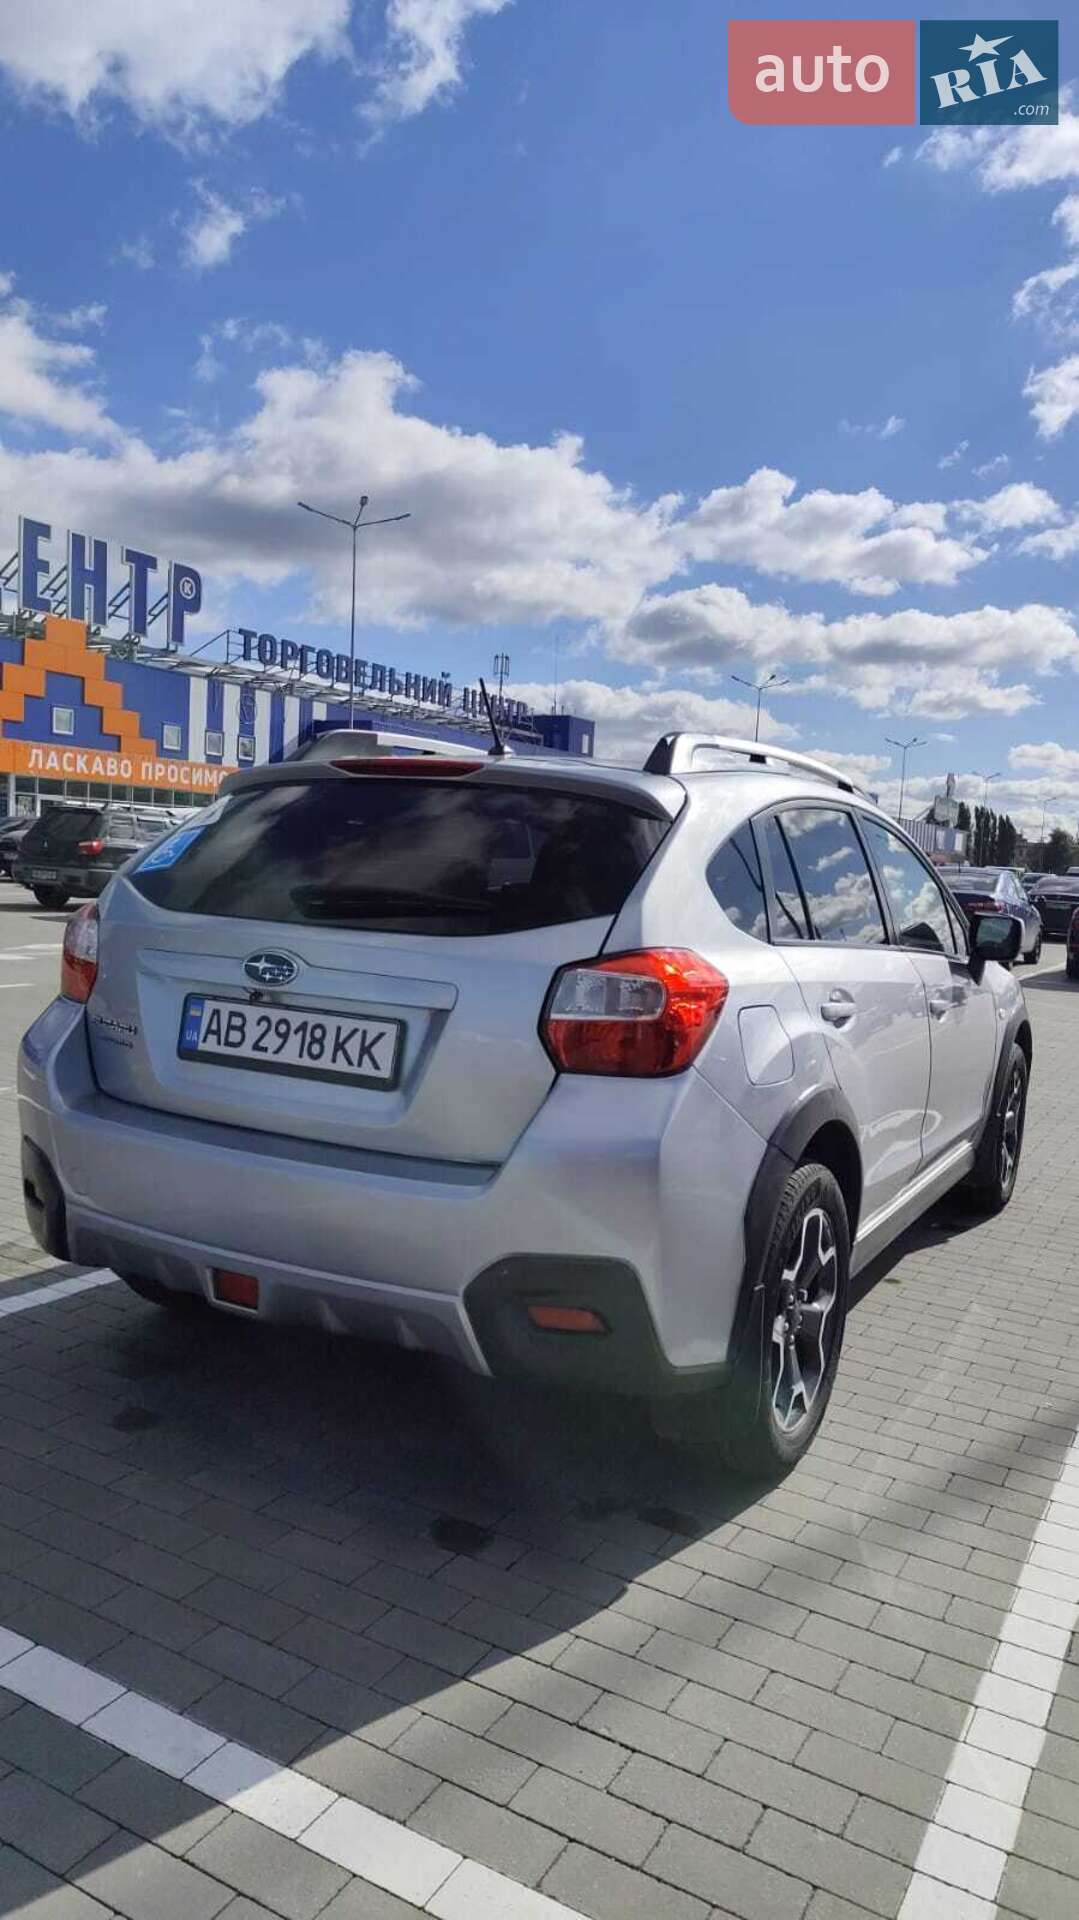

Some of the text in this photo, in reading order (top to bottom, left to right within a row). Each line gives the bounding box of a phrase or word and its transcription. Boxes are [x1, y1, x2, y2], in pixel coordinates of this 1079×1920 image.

[0, 515, 202, 646] ЕНТР
[238, 628, 453, 708] ТОРГОВЕЛЬНИЙ
[28, 748, 132, 777] ЛАСКАВО
[251, 1015, 327, 1061] 2918
